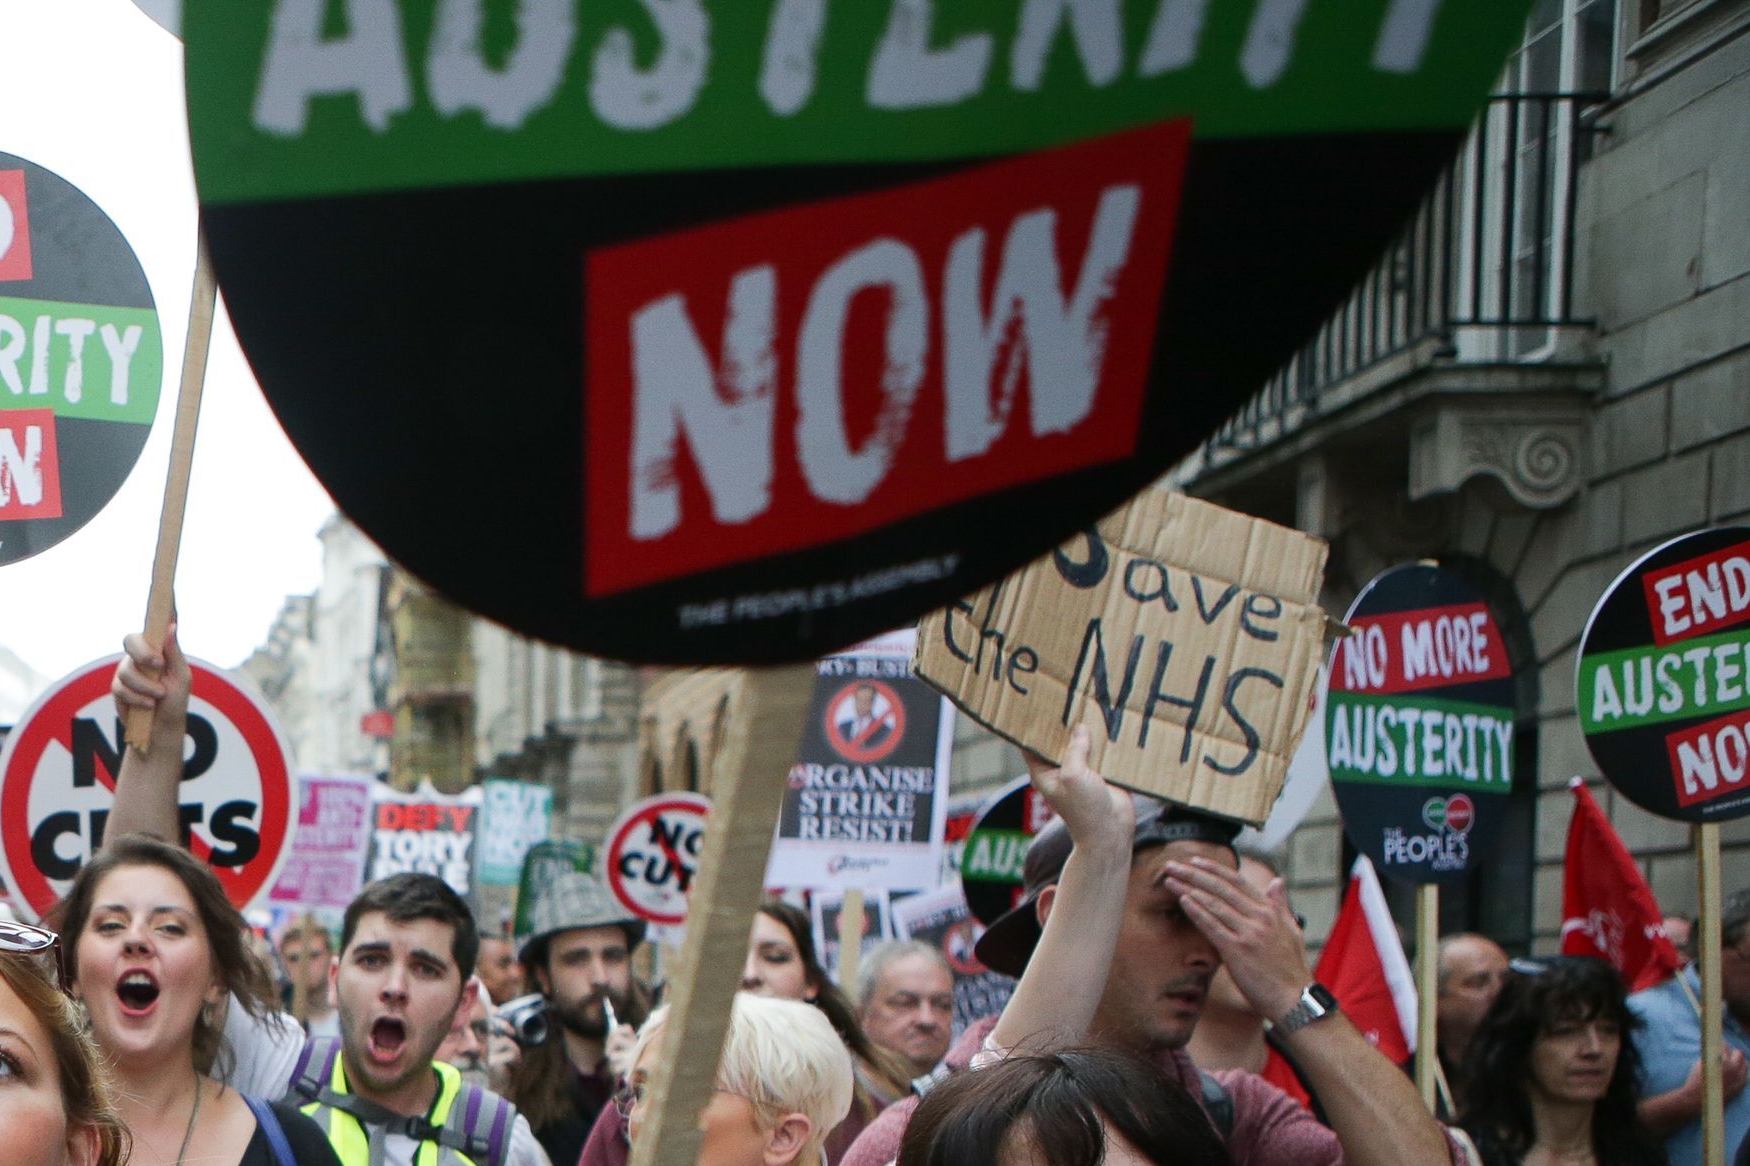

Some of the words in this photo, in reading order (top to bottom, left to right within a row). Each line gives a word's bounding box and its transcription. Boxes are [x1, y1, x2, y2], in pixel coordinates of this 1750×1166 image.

[253, 0, 1445, 133] AUSTE
[630, 185, 1142, 540] NOW
[1654, 556, 1750, 636] END
[1344, 623, 1387, 690] NO
[1401, 612, 1490, 682] MORE
[1592, 642, 1750, 722] AUSTE
[1062, 617, 1284, 776] NHS
[1330, 703, 1514, 783] AUSTERITY
[1677, 724, 1750, 796] NO
[30, 800, 261, 881] CTS
[377, 804, 474, 832] DEFY
[800, 788, 916, 819] STRIKE
[375, 830, 473, 861] TORY
[619, 851, 694, 893] CUT
